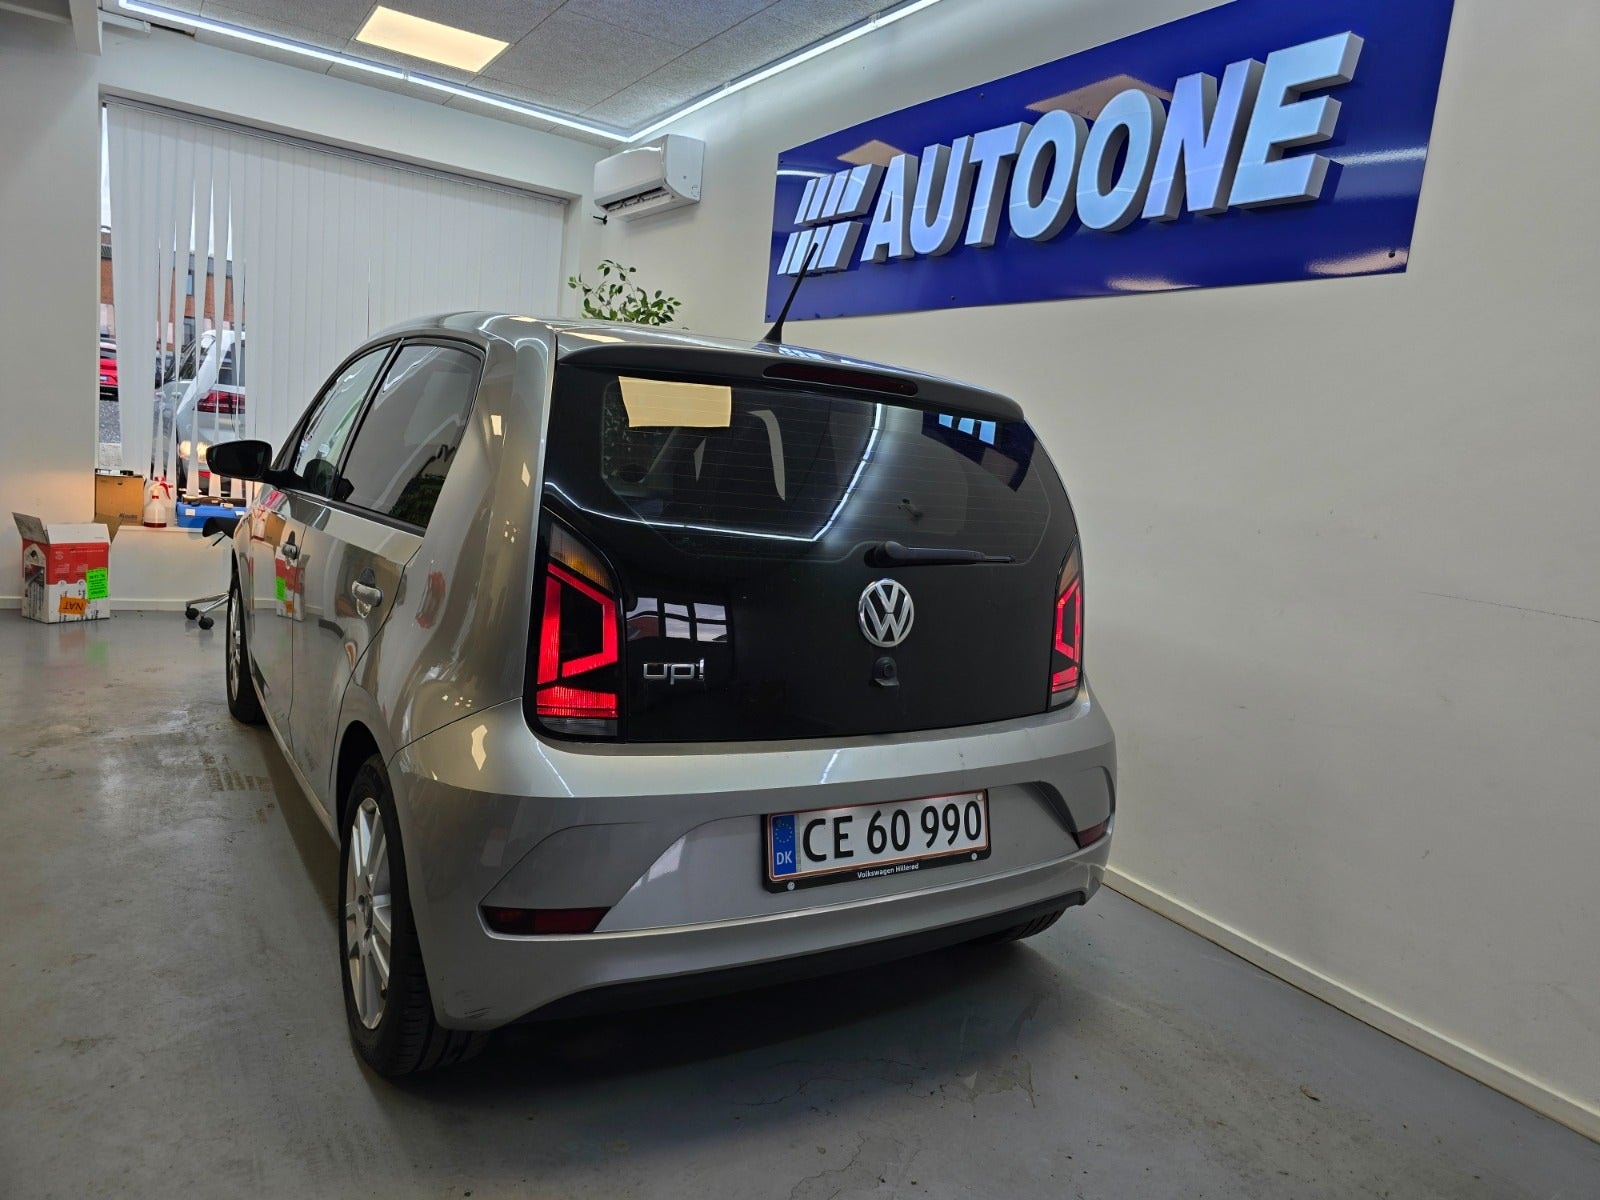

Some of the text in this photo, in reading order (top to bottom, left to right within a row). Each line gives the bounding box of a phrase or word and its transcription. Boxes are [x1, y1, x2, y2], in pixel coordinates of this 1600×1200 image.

[861, 31, 1364, 264] AUTOONE
[63, 601, 83, 611] NAT
[802, 800, 982, 862] CE 60 990
[776, 850, 793, 866] DK
[857, 867, 895, 879] Volkswagen
